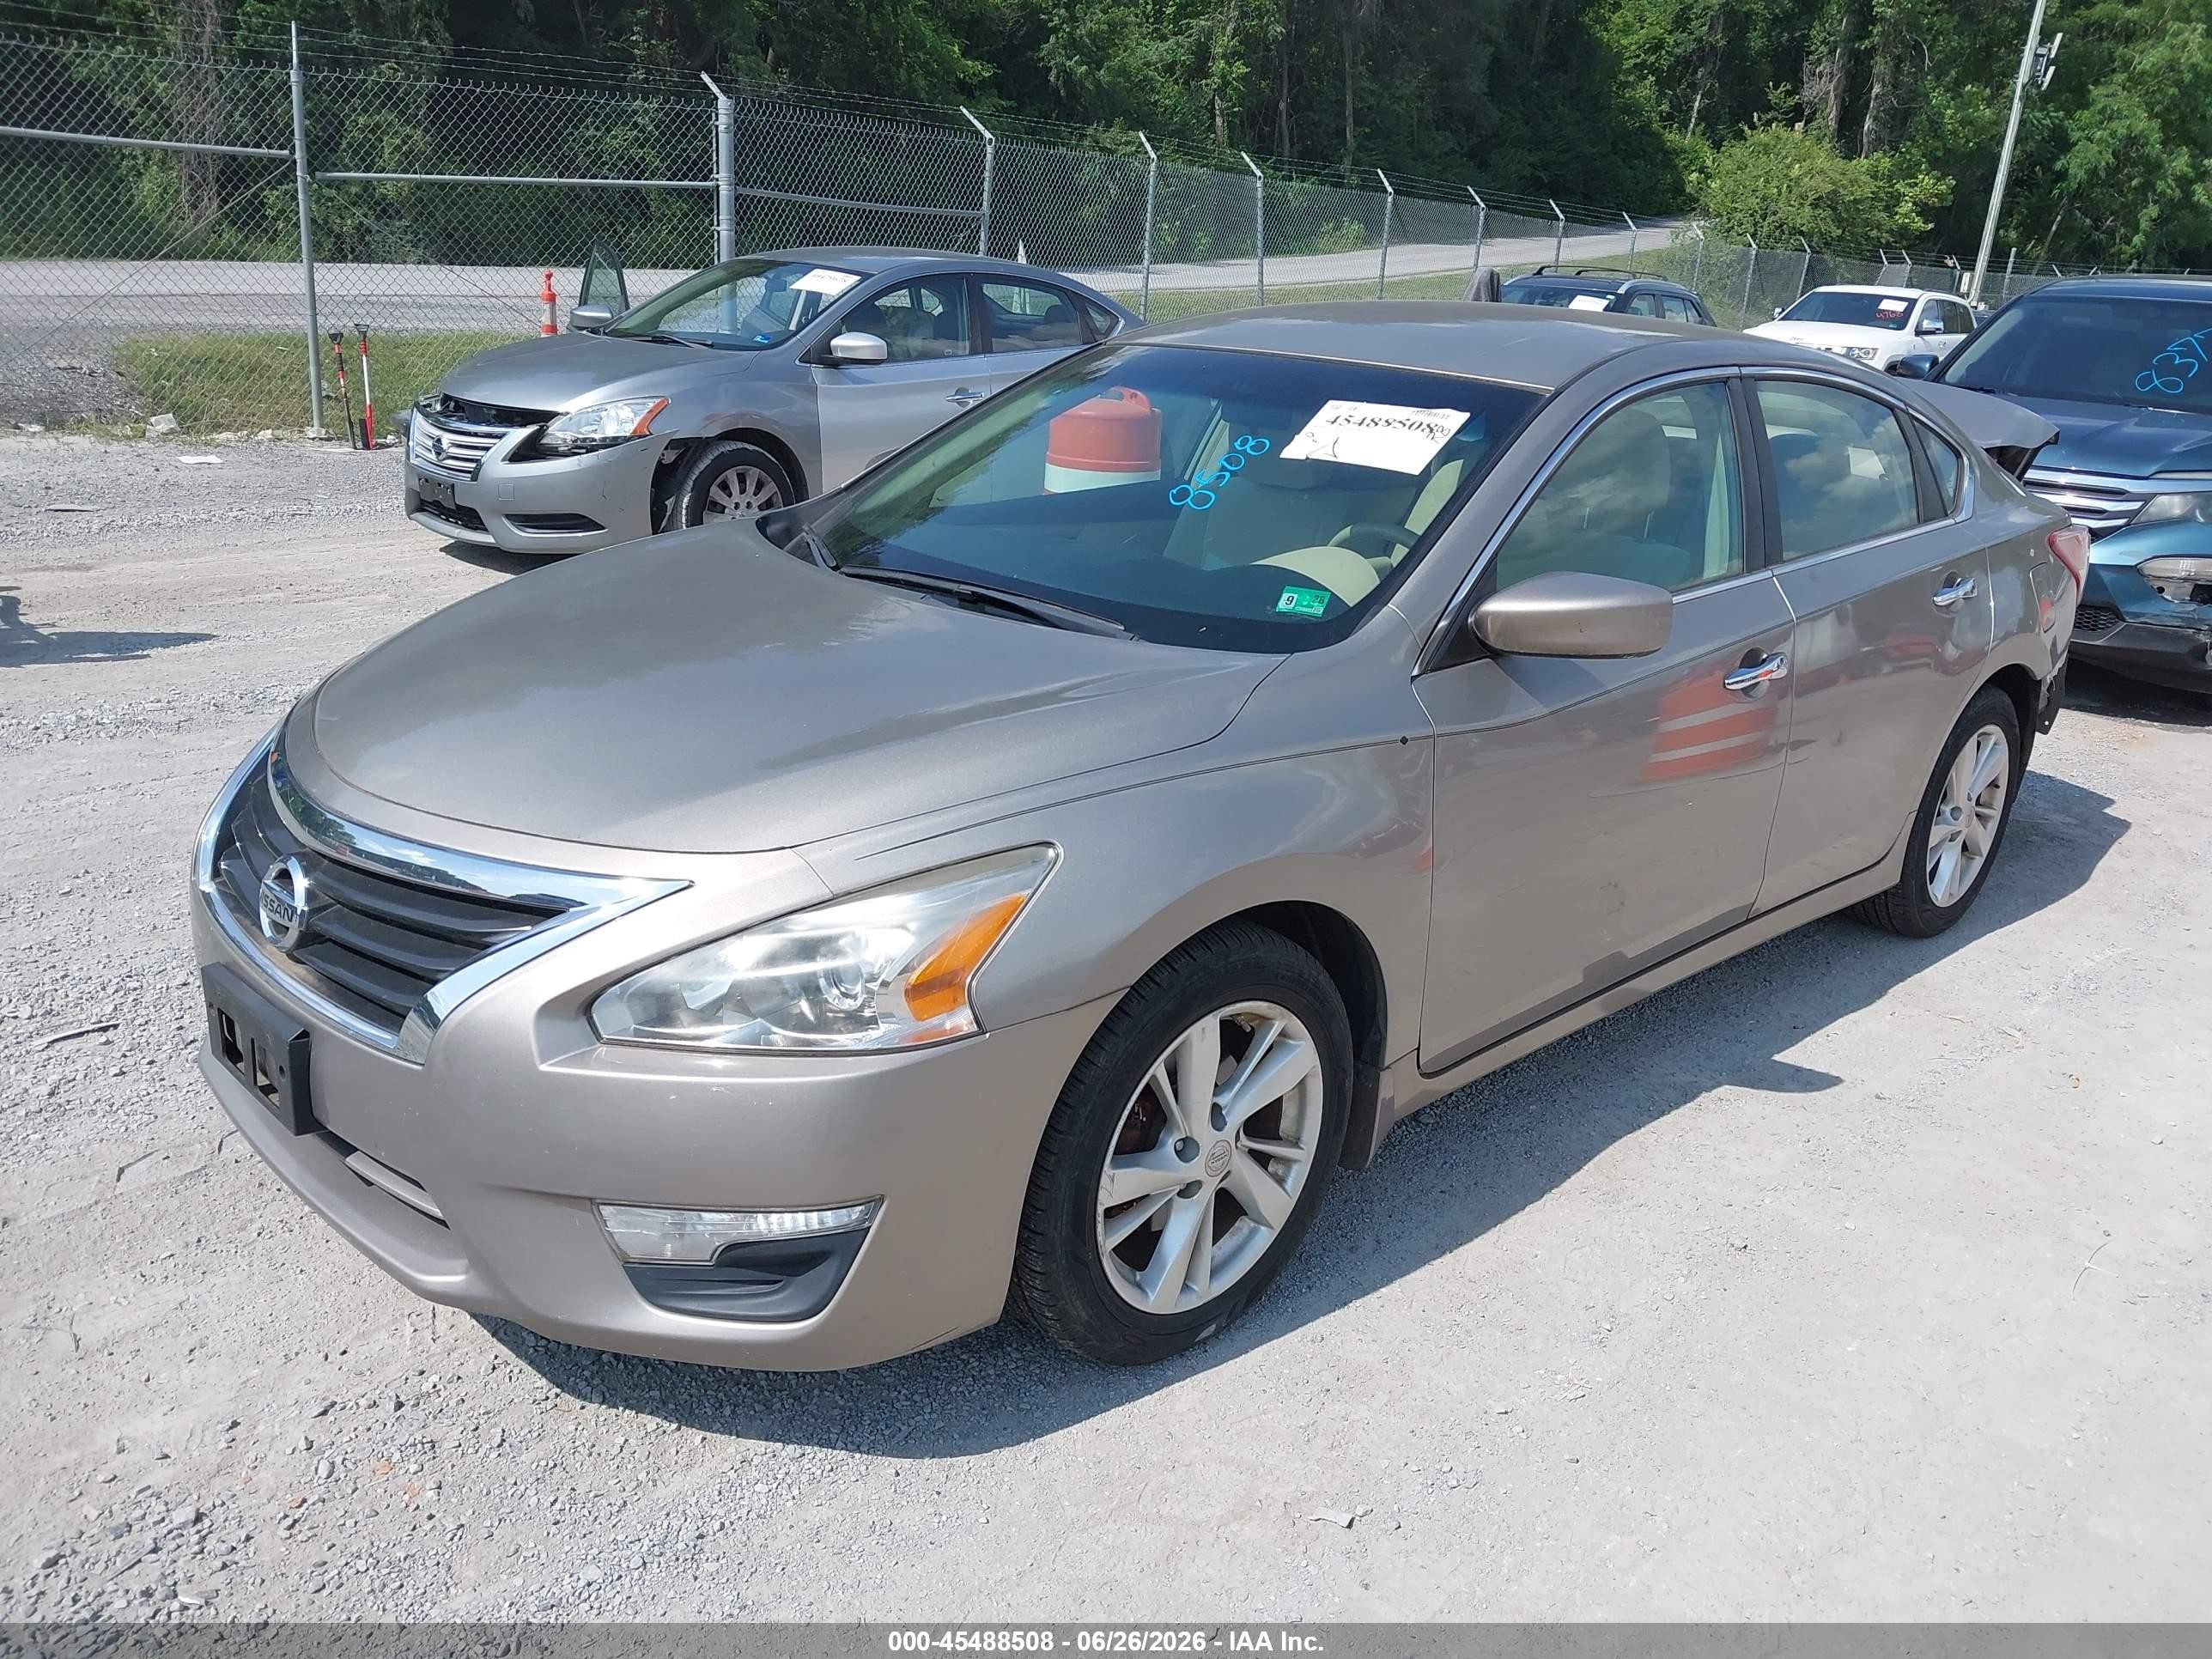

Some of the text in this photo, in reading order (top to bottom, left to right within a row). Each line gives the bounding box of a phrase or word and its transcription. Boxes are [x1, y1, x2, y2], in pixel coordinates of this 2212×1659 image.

[1326, 414, 1440, 434] 45488508
[1169, 435, 1270, 510] 8508
[1285, 595, 1295, 605] 9
